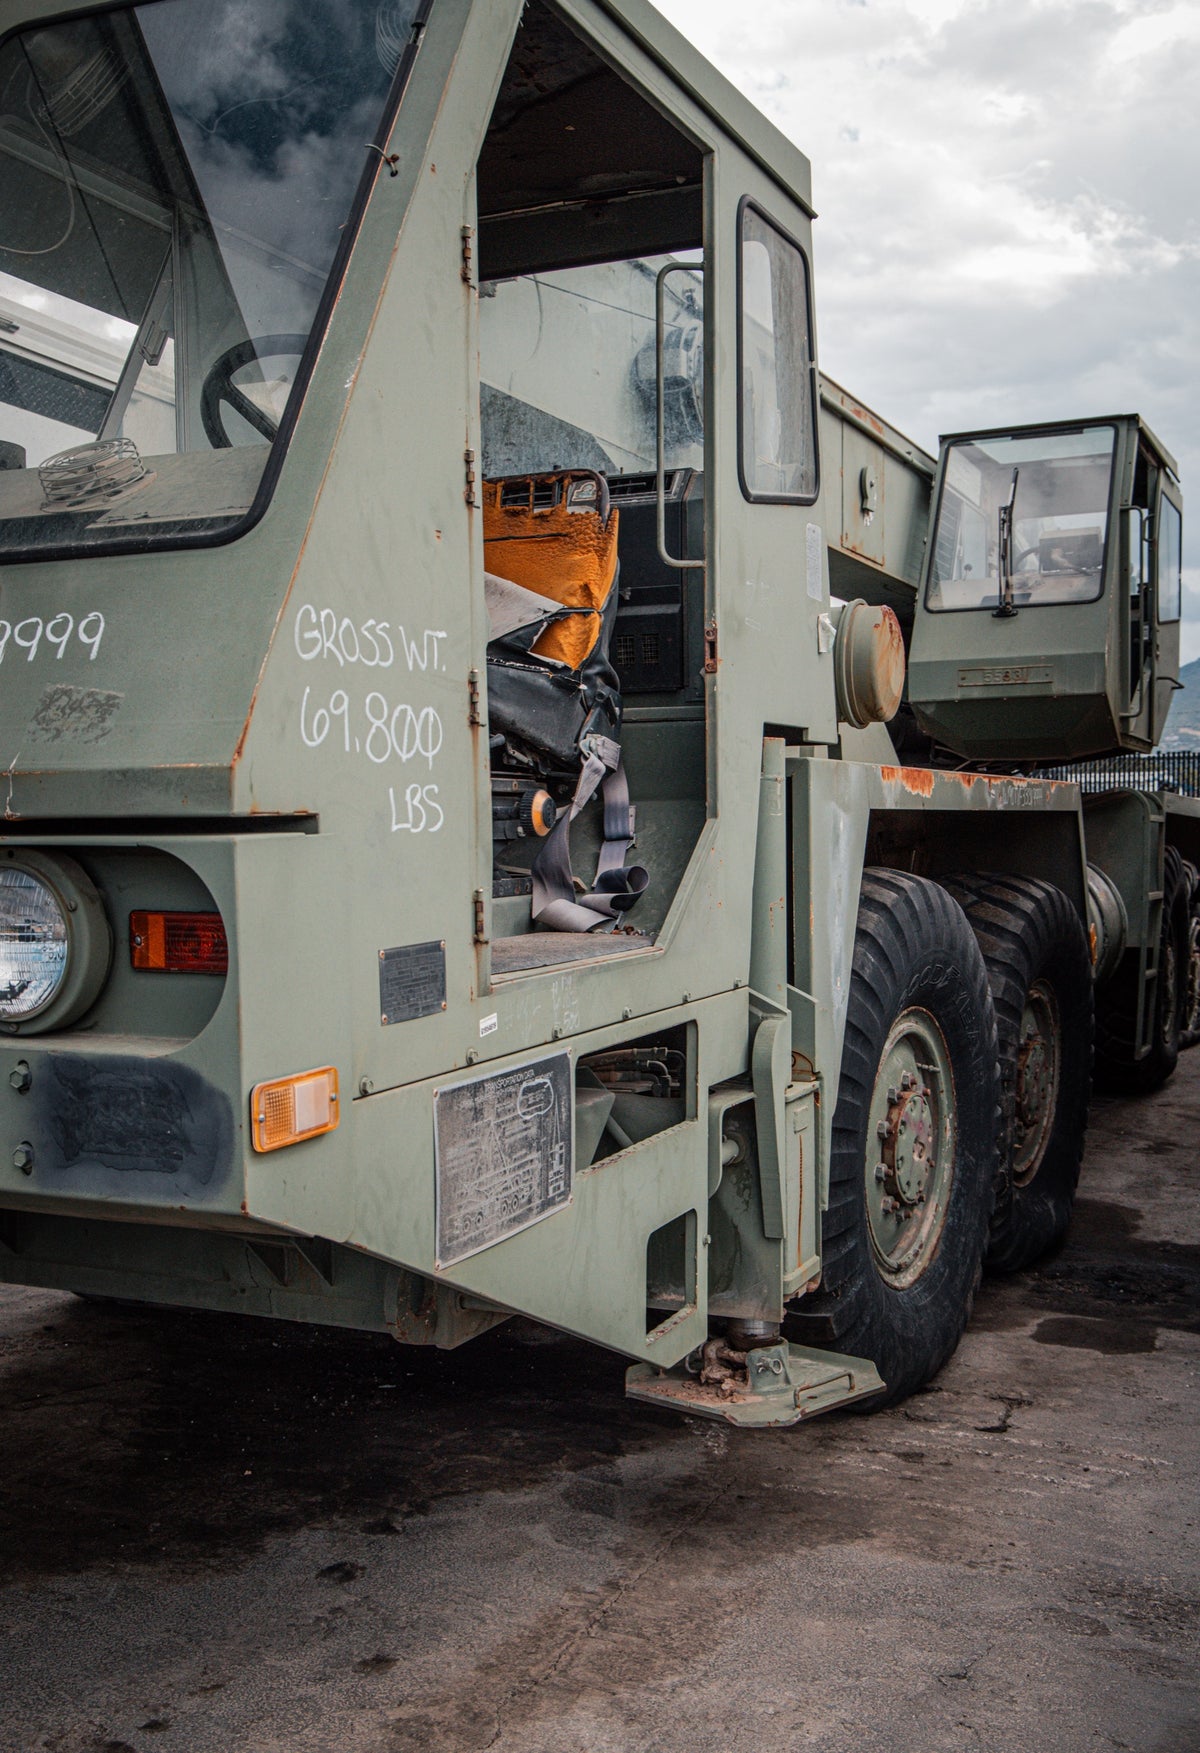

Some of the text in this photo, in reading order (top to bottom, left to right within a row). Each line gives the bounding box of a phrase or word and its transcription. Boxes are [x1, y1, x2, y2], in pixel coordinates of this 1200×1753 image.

[295, 604, 448, 672] GROSS WT.
[389, 784, 444, 833] LBS
